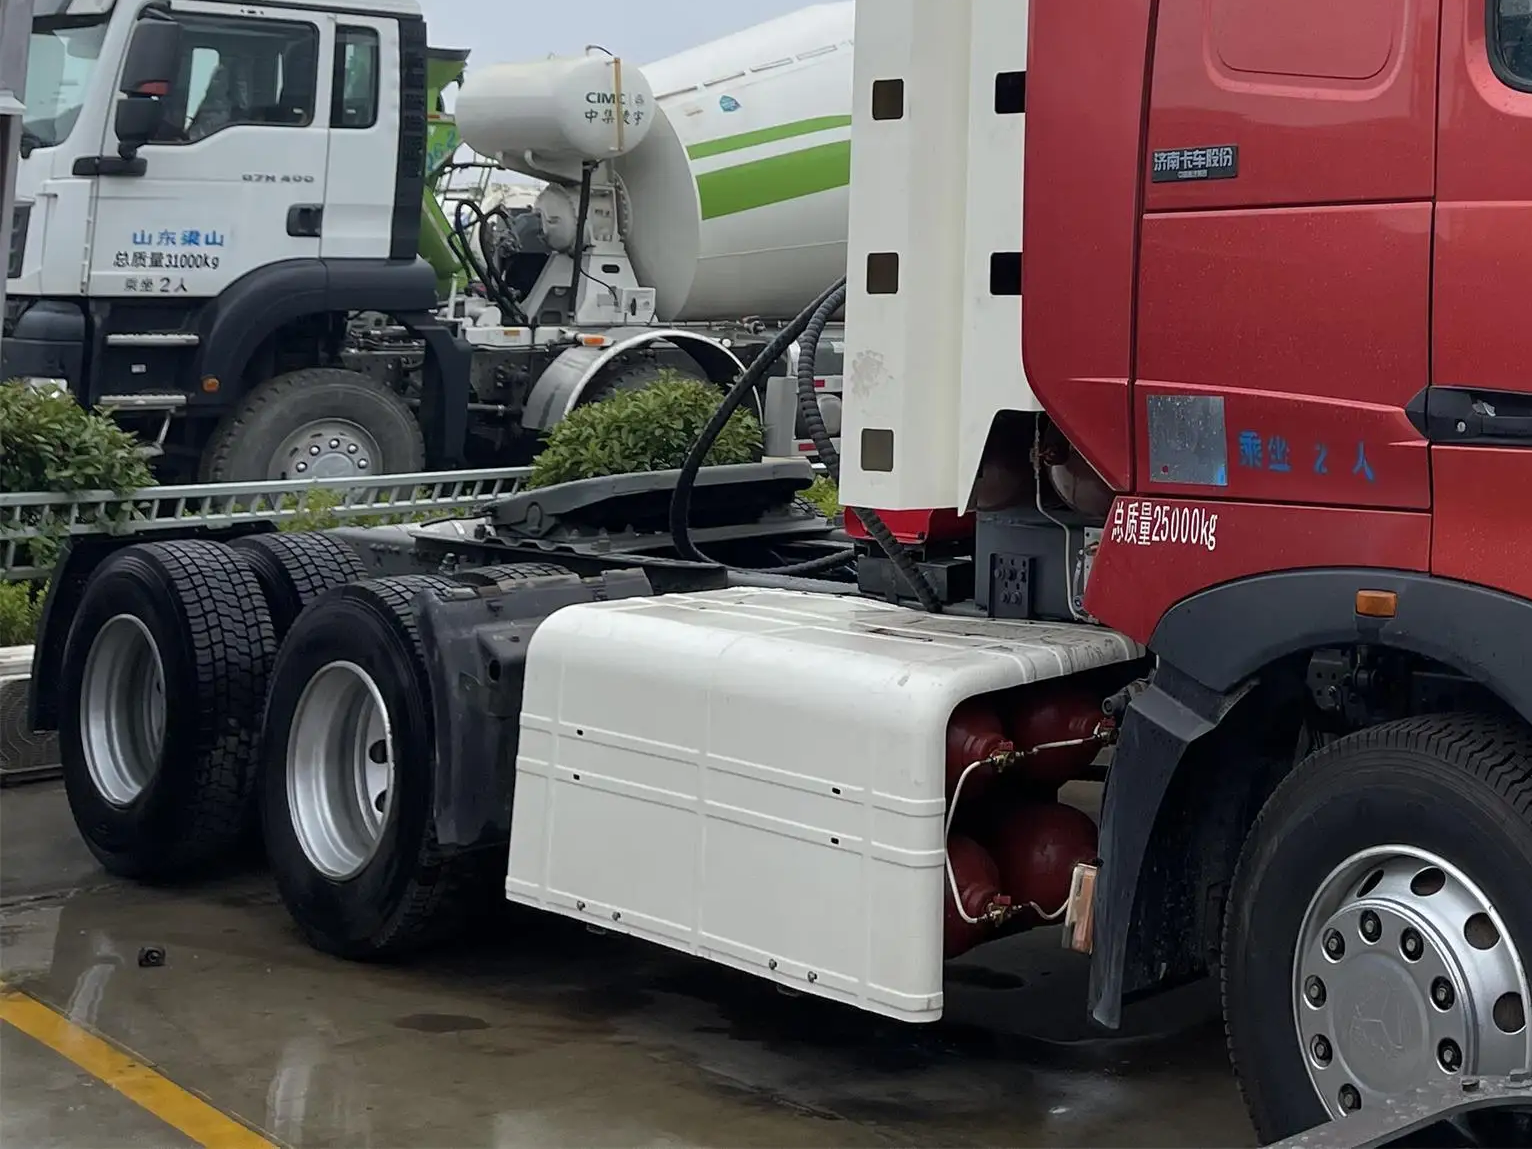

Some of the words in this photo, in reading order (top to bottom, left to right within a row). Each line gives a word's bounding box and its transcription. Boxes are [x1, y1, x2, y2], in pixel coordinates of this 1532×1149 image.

[1153, 147, 1233, 171] 济南卡车股份
[132, 229, 225, 247] 山东梁山
[113, 251, 220, 270] 总质量31000kg
[1111, 501, 1218, 551] 总质量25000kg
